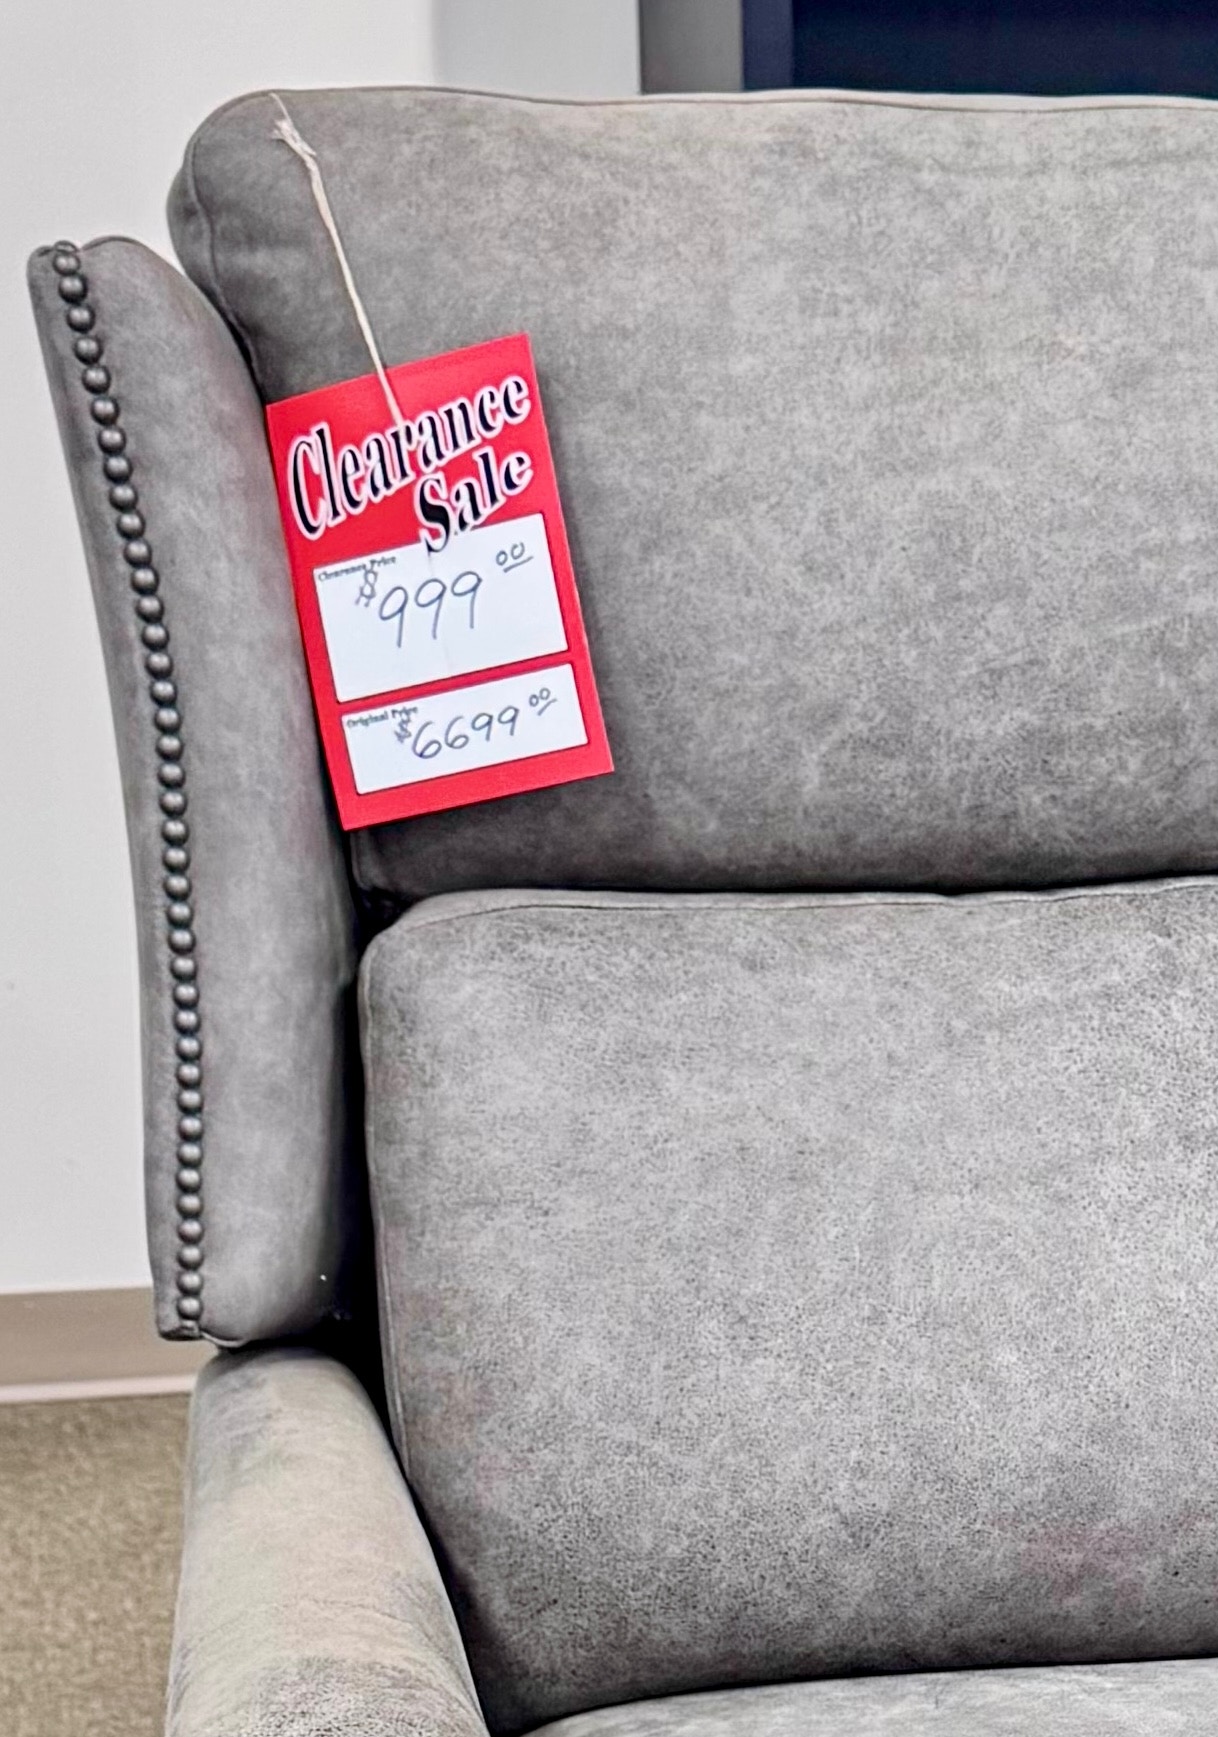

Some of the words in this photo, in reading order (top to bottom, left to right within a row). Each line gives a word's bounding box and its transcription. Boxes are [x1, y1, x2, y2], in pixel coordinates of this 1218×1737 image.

[289, 375, 532, 539] Clearance
[416, 449, 533, 554] Sale
[369, 554, 396, 571] Price
[346, 708, 389, 728] Original
[390, 705, 418, 721] Price
